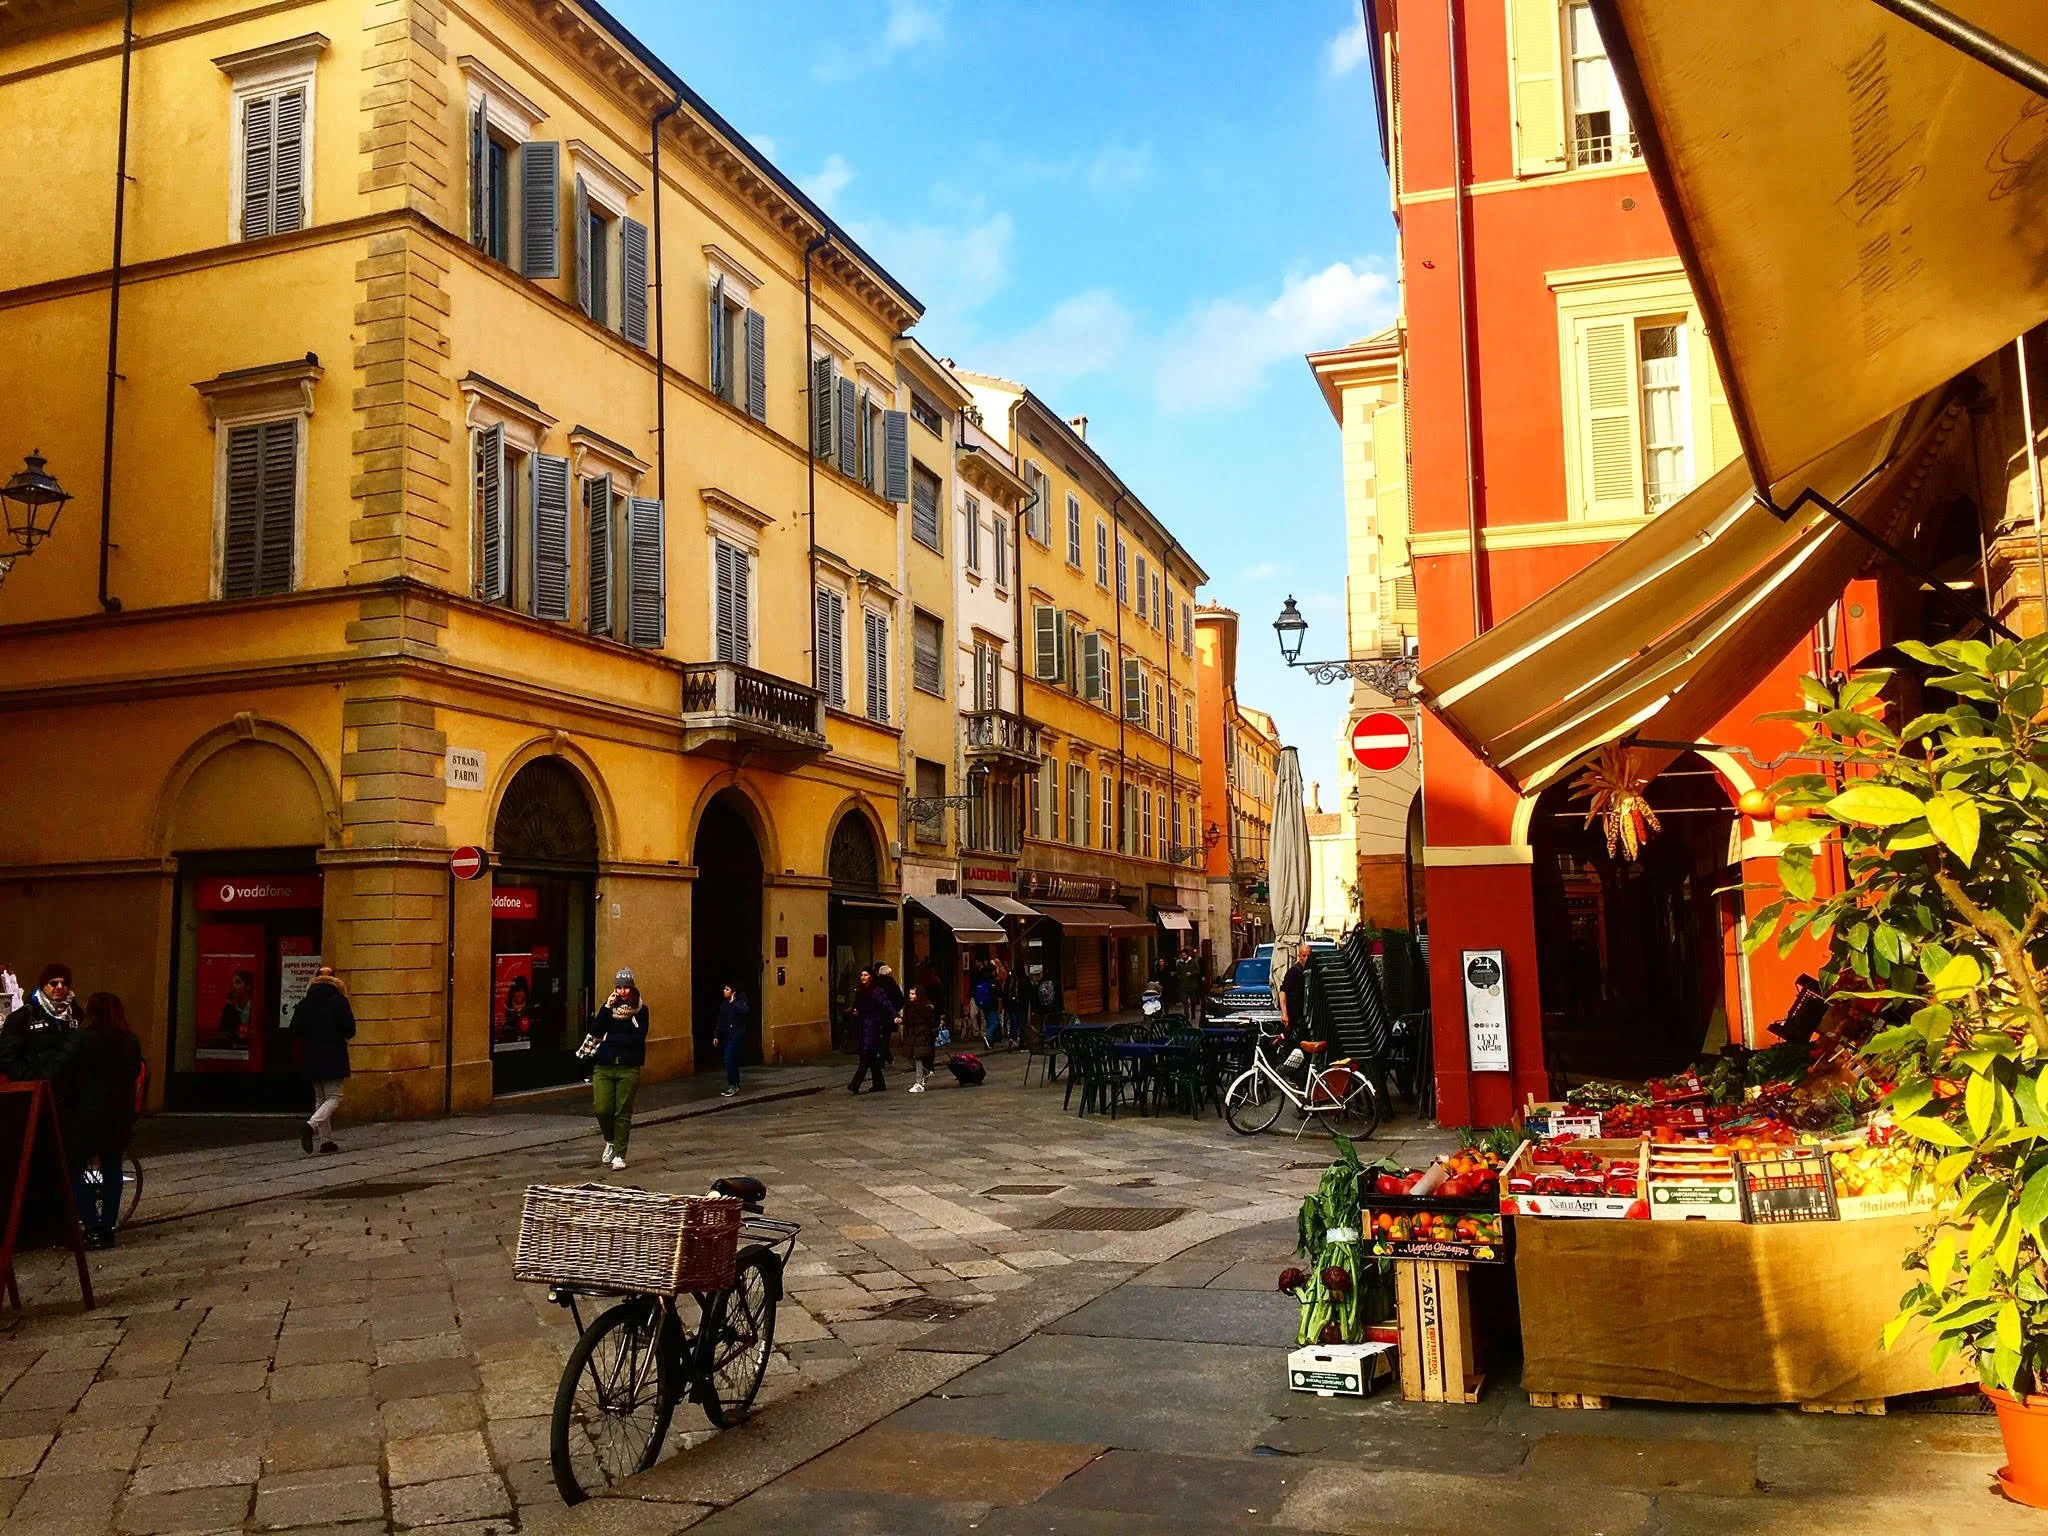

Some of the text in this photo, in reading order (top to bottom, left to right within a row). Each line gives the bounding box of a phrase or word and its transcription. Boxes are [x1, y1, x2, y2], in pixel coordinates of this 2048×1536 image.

[452, 755, 479, 767] STRADA
[454, 770, 478, 782] FARINI
[237, 885, 291, 897] vodafone
[1549, 1199, 1598, 1212] NaturAgri
[1422, 1278, 1436, 1327] ASTA
